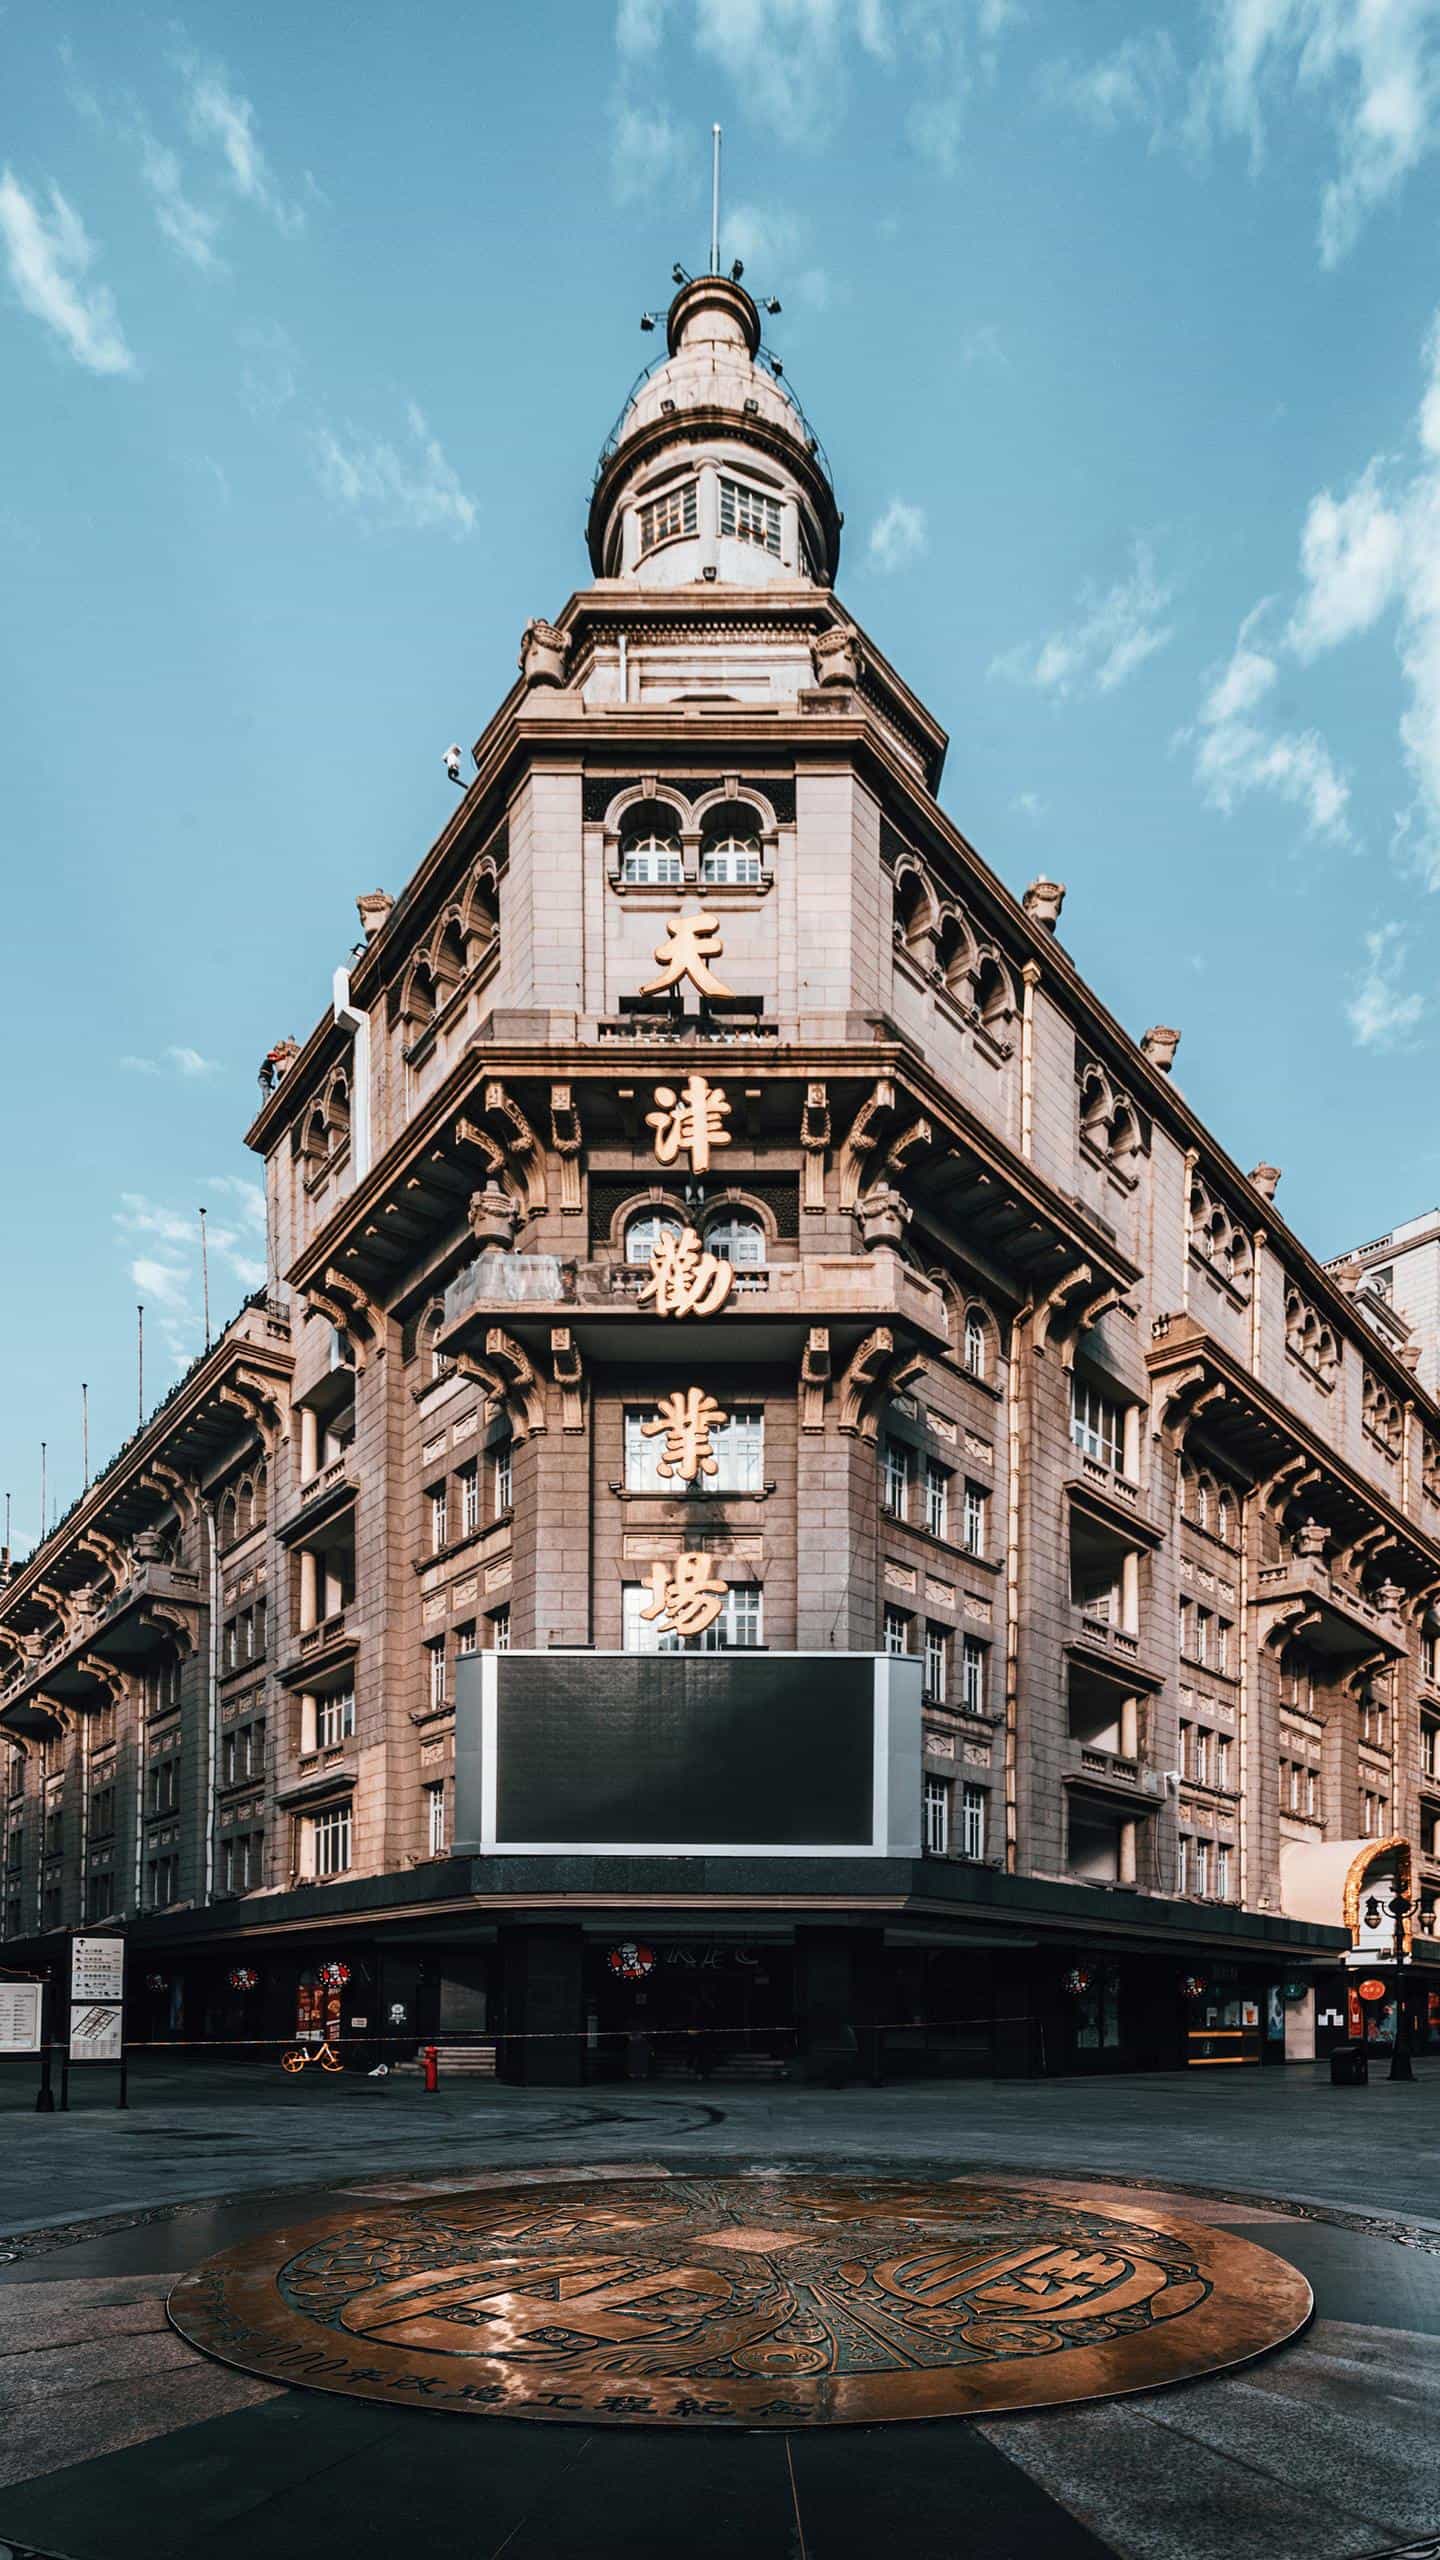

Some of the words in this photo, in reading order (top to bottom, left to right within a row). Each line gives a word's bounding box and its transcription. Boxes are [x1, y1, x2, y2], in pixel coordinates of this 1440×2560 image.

[640, 912, 736, 1637] 天津勸業場
